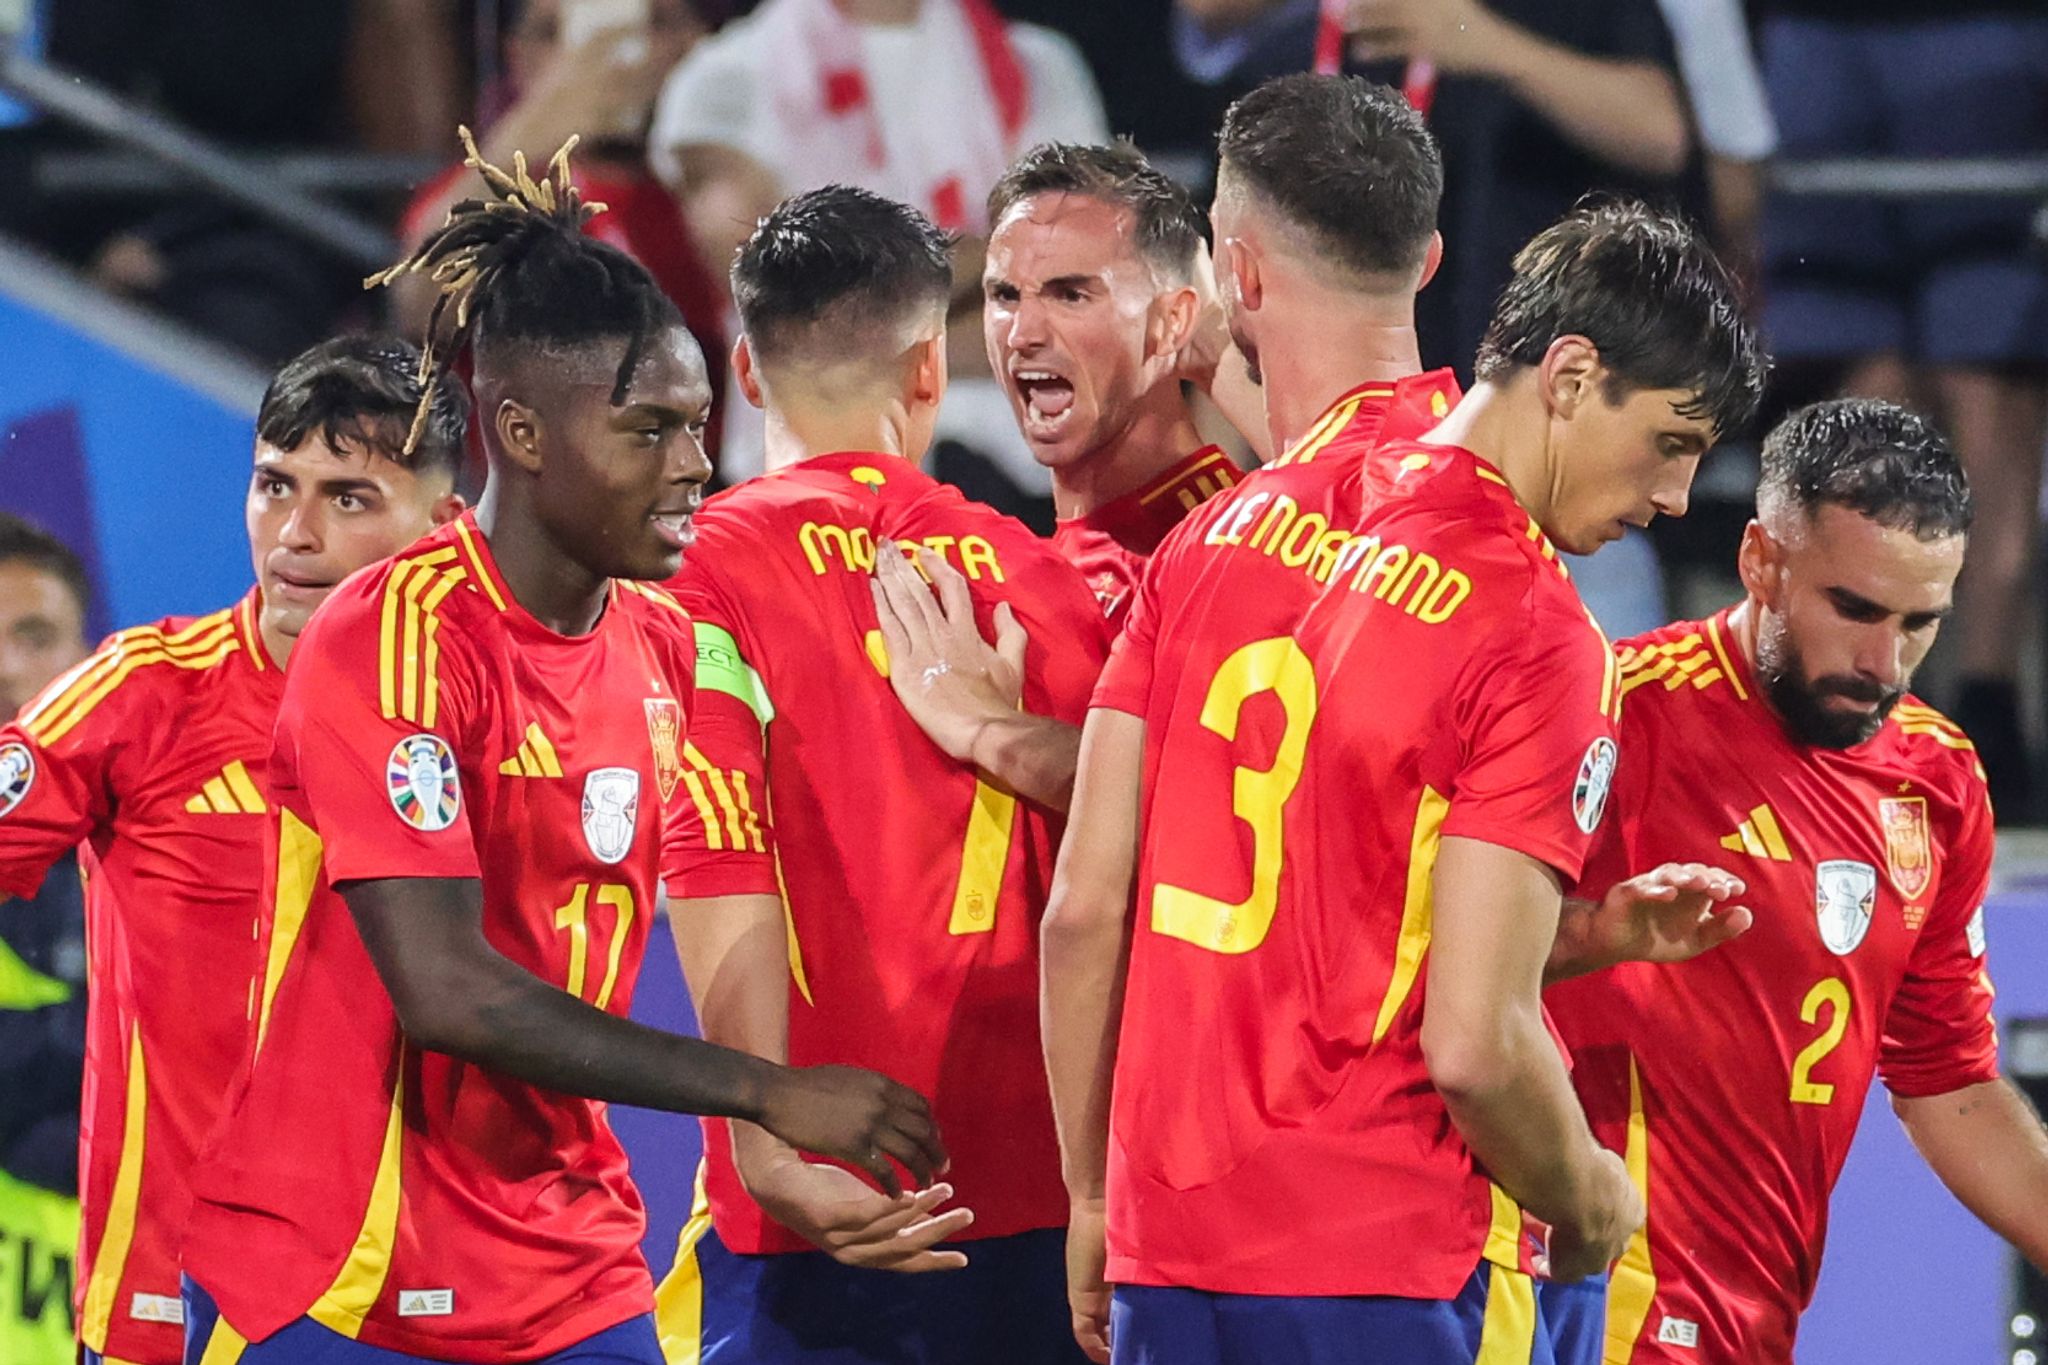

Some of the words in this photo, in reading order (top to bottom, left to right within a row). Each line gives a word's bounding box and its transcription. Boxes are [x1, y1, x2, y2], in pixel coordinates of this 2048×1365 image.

[798, 520, 1007, 584] MOATA
[1151, 635, 1319, 954] 3
[554, 882, 635, 1011] 17
[1788, 975, 1852, 1106] 2
